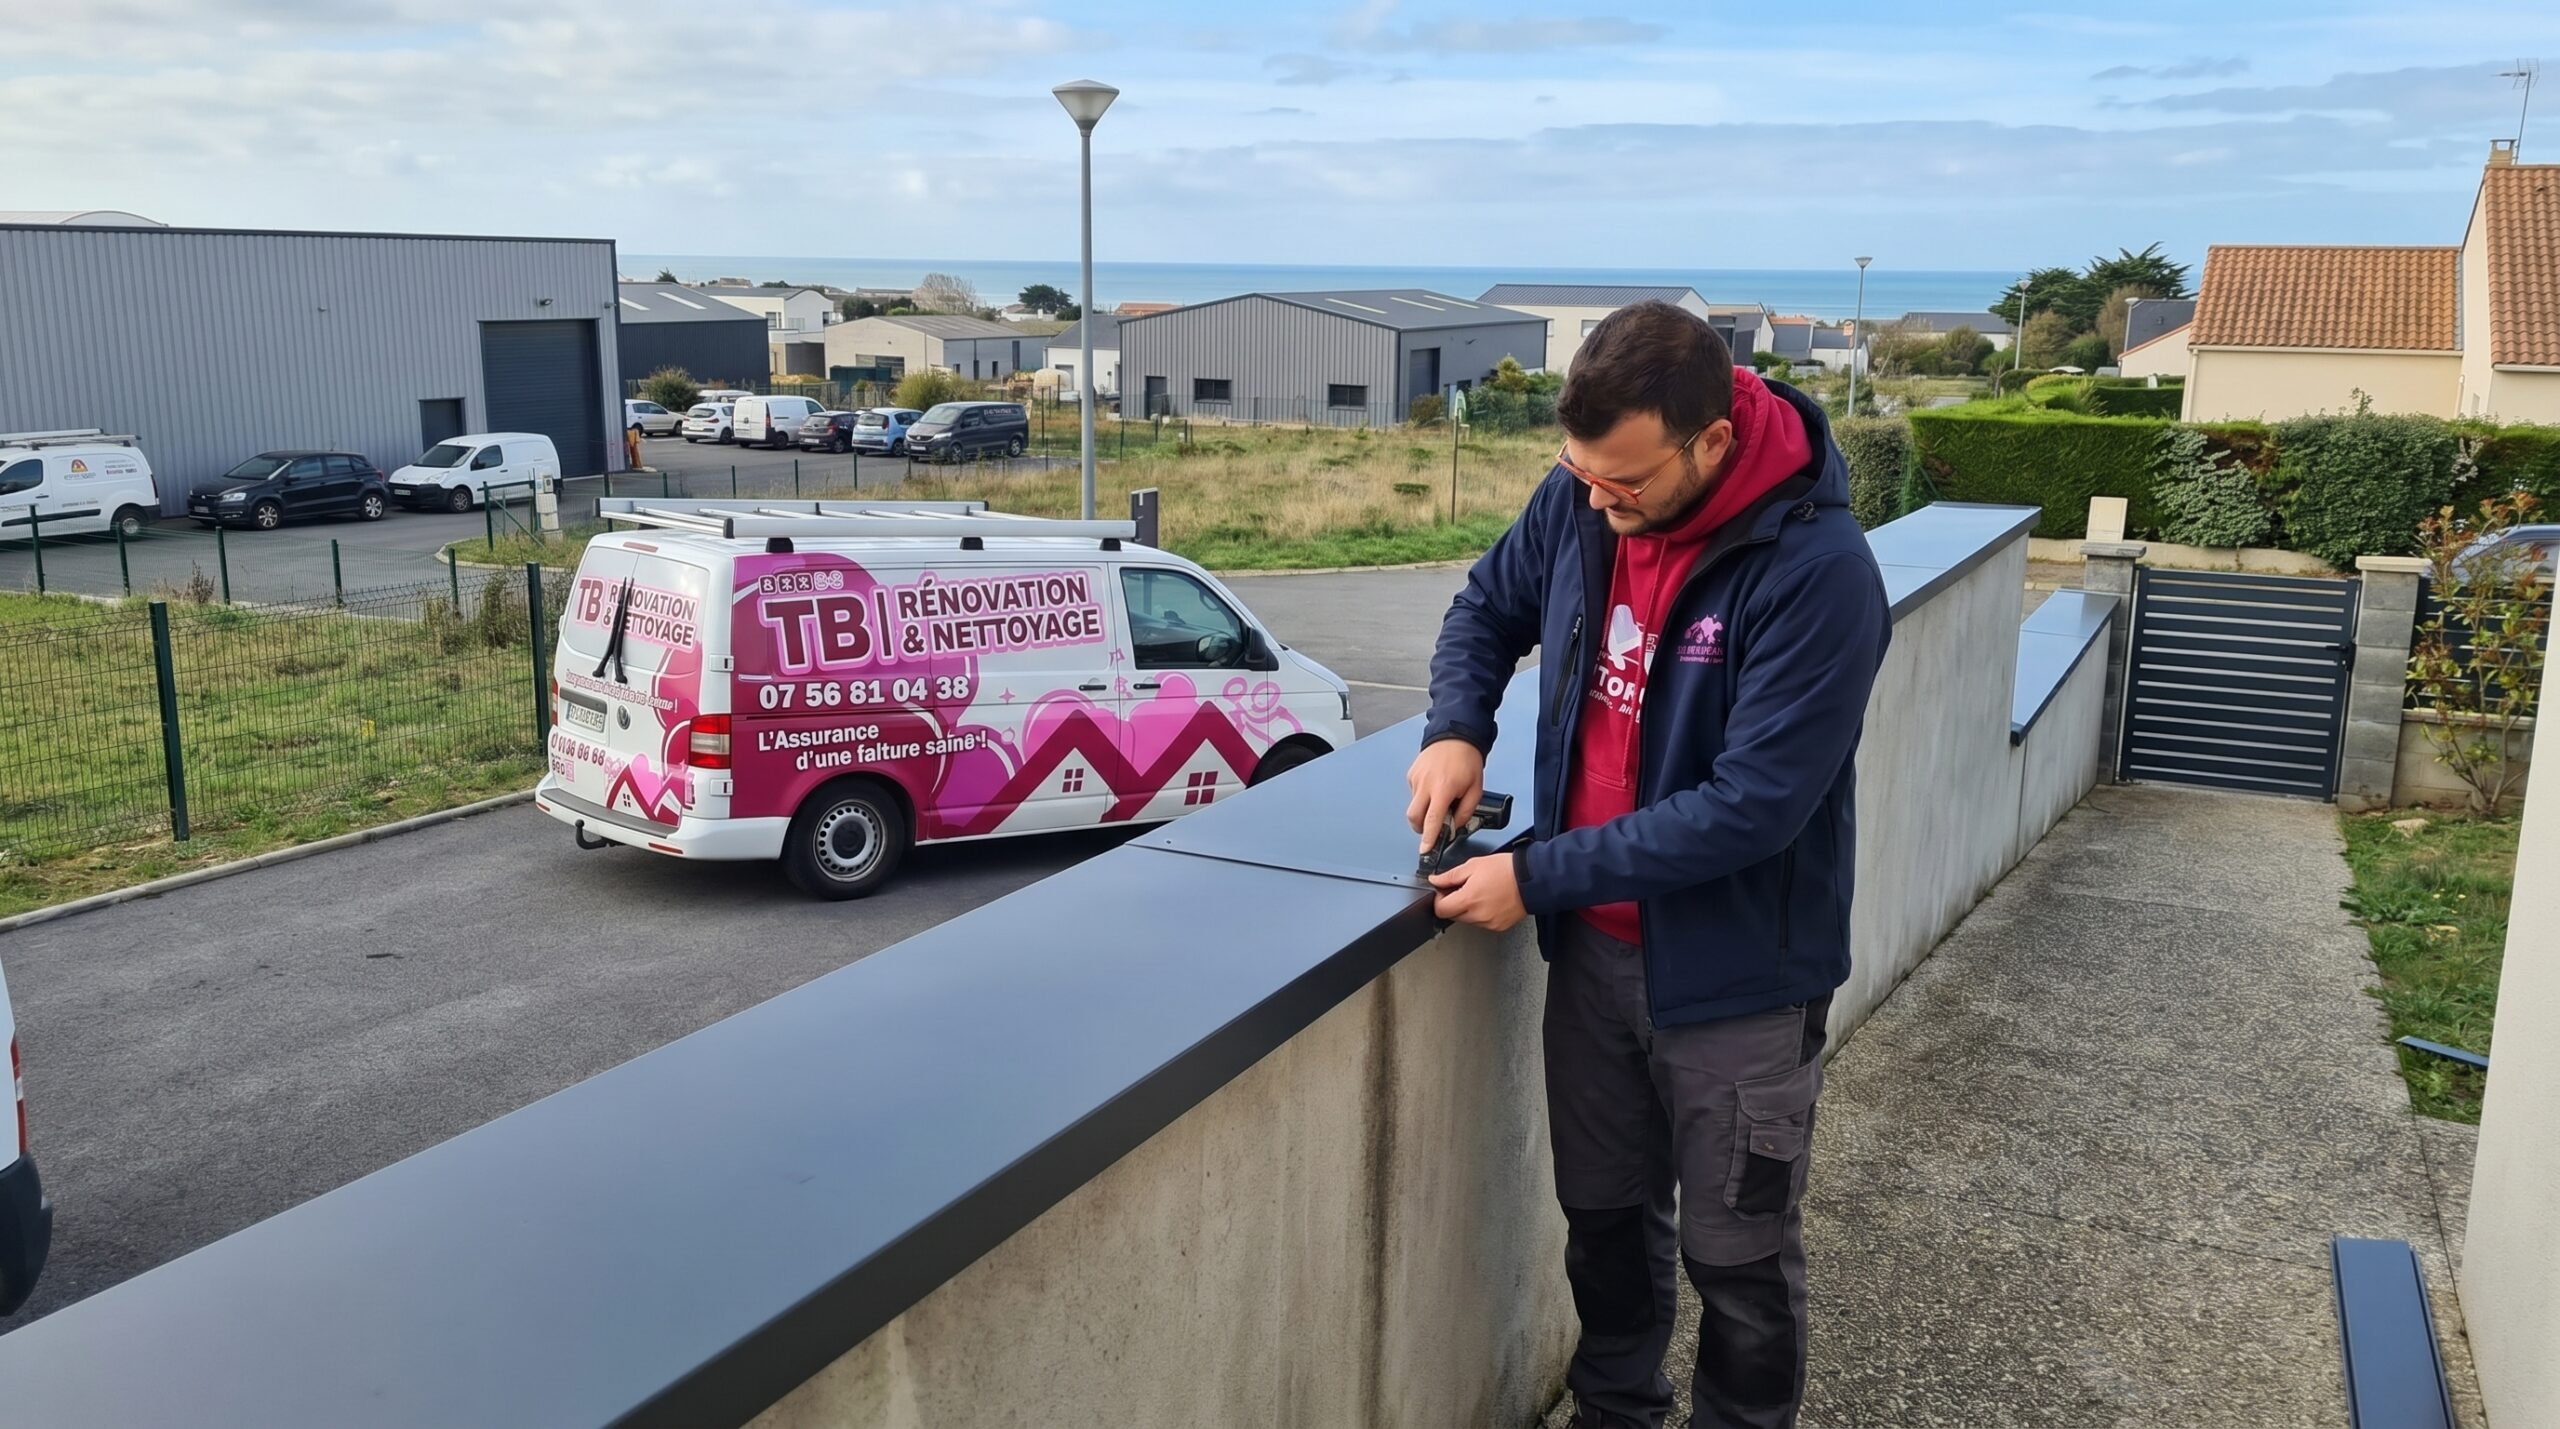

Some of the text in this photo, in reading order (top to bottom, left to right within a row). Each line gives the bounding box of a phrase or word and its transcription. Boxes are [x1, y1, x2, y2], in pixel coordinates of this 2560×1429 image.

[577, 579, 604, 622] TB
[898, 578, 1087, 619] RÉNOVATION
[624, 611, 695, 647] ETTOYAGE
[765, 596, 871, 666] TB
[903, 608, 1100, 653] & NETTOYAGE
[759, 675, 970, 709] 07 56 81 04 38
[758, 724, 879, 752] L'Assurance
[796, 749, 852, 771] d'une
